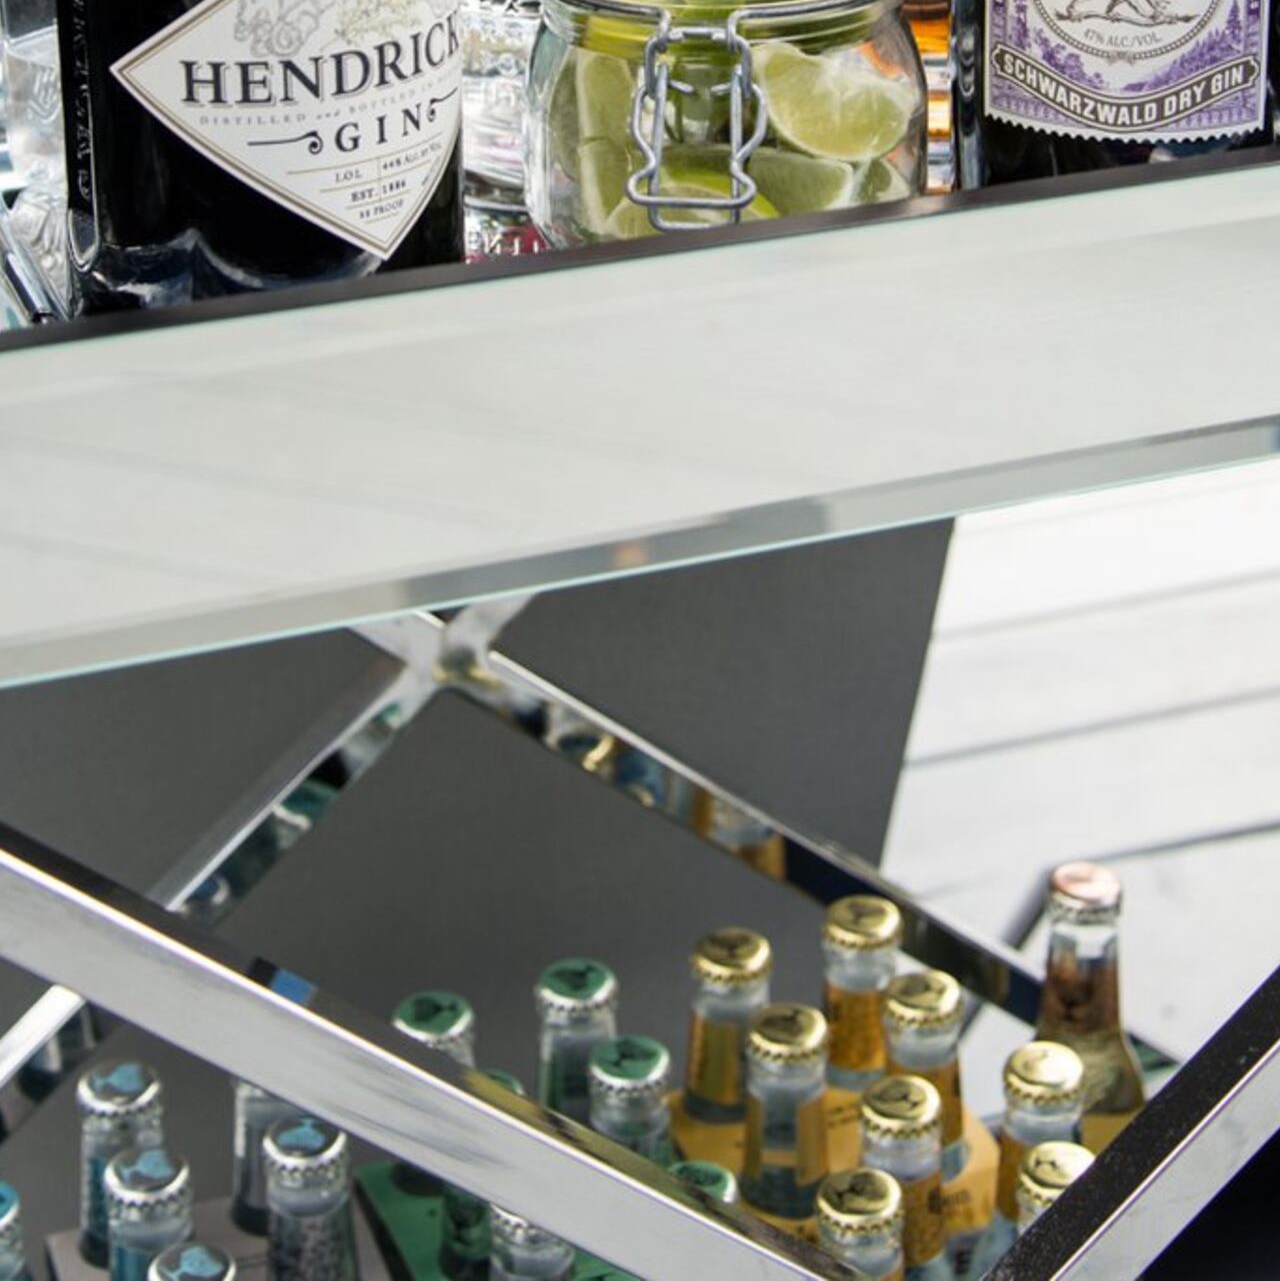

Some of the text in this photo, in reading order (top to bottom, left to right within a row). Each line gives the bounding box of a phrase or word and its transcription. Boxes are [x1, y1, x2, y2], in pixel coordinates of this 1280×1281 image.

[200, 113, 307, 126] DISTILLED
[349, 89, 417, 115] BOTTLED
[1003, 54, 1245, 126] SCHWARZWALD DRY GIN
[335, 103, 422, 153] GIN
[350, 188, 379, 203] EST.
[373, 198, 405, 215] PROOF
